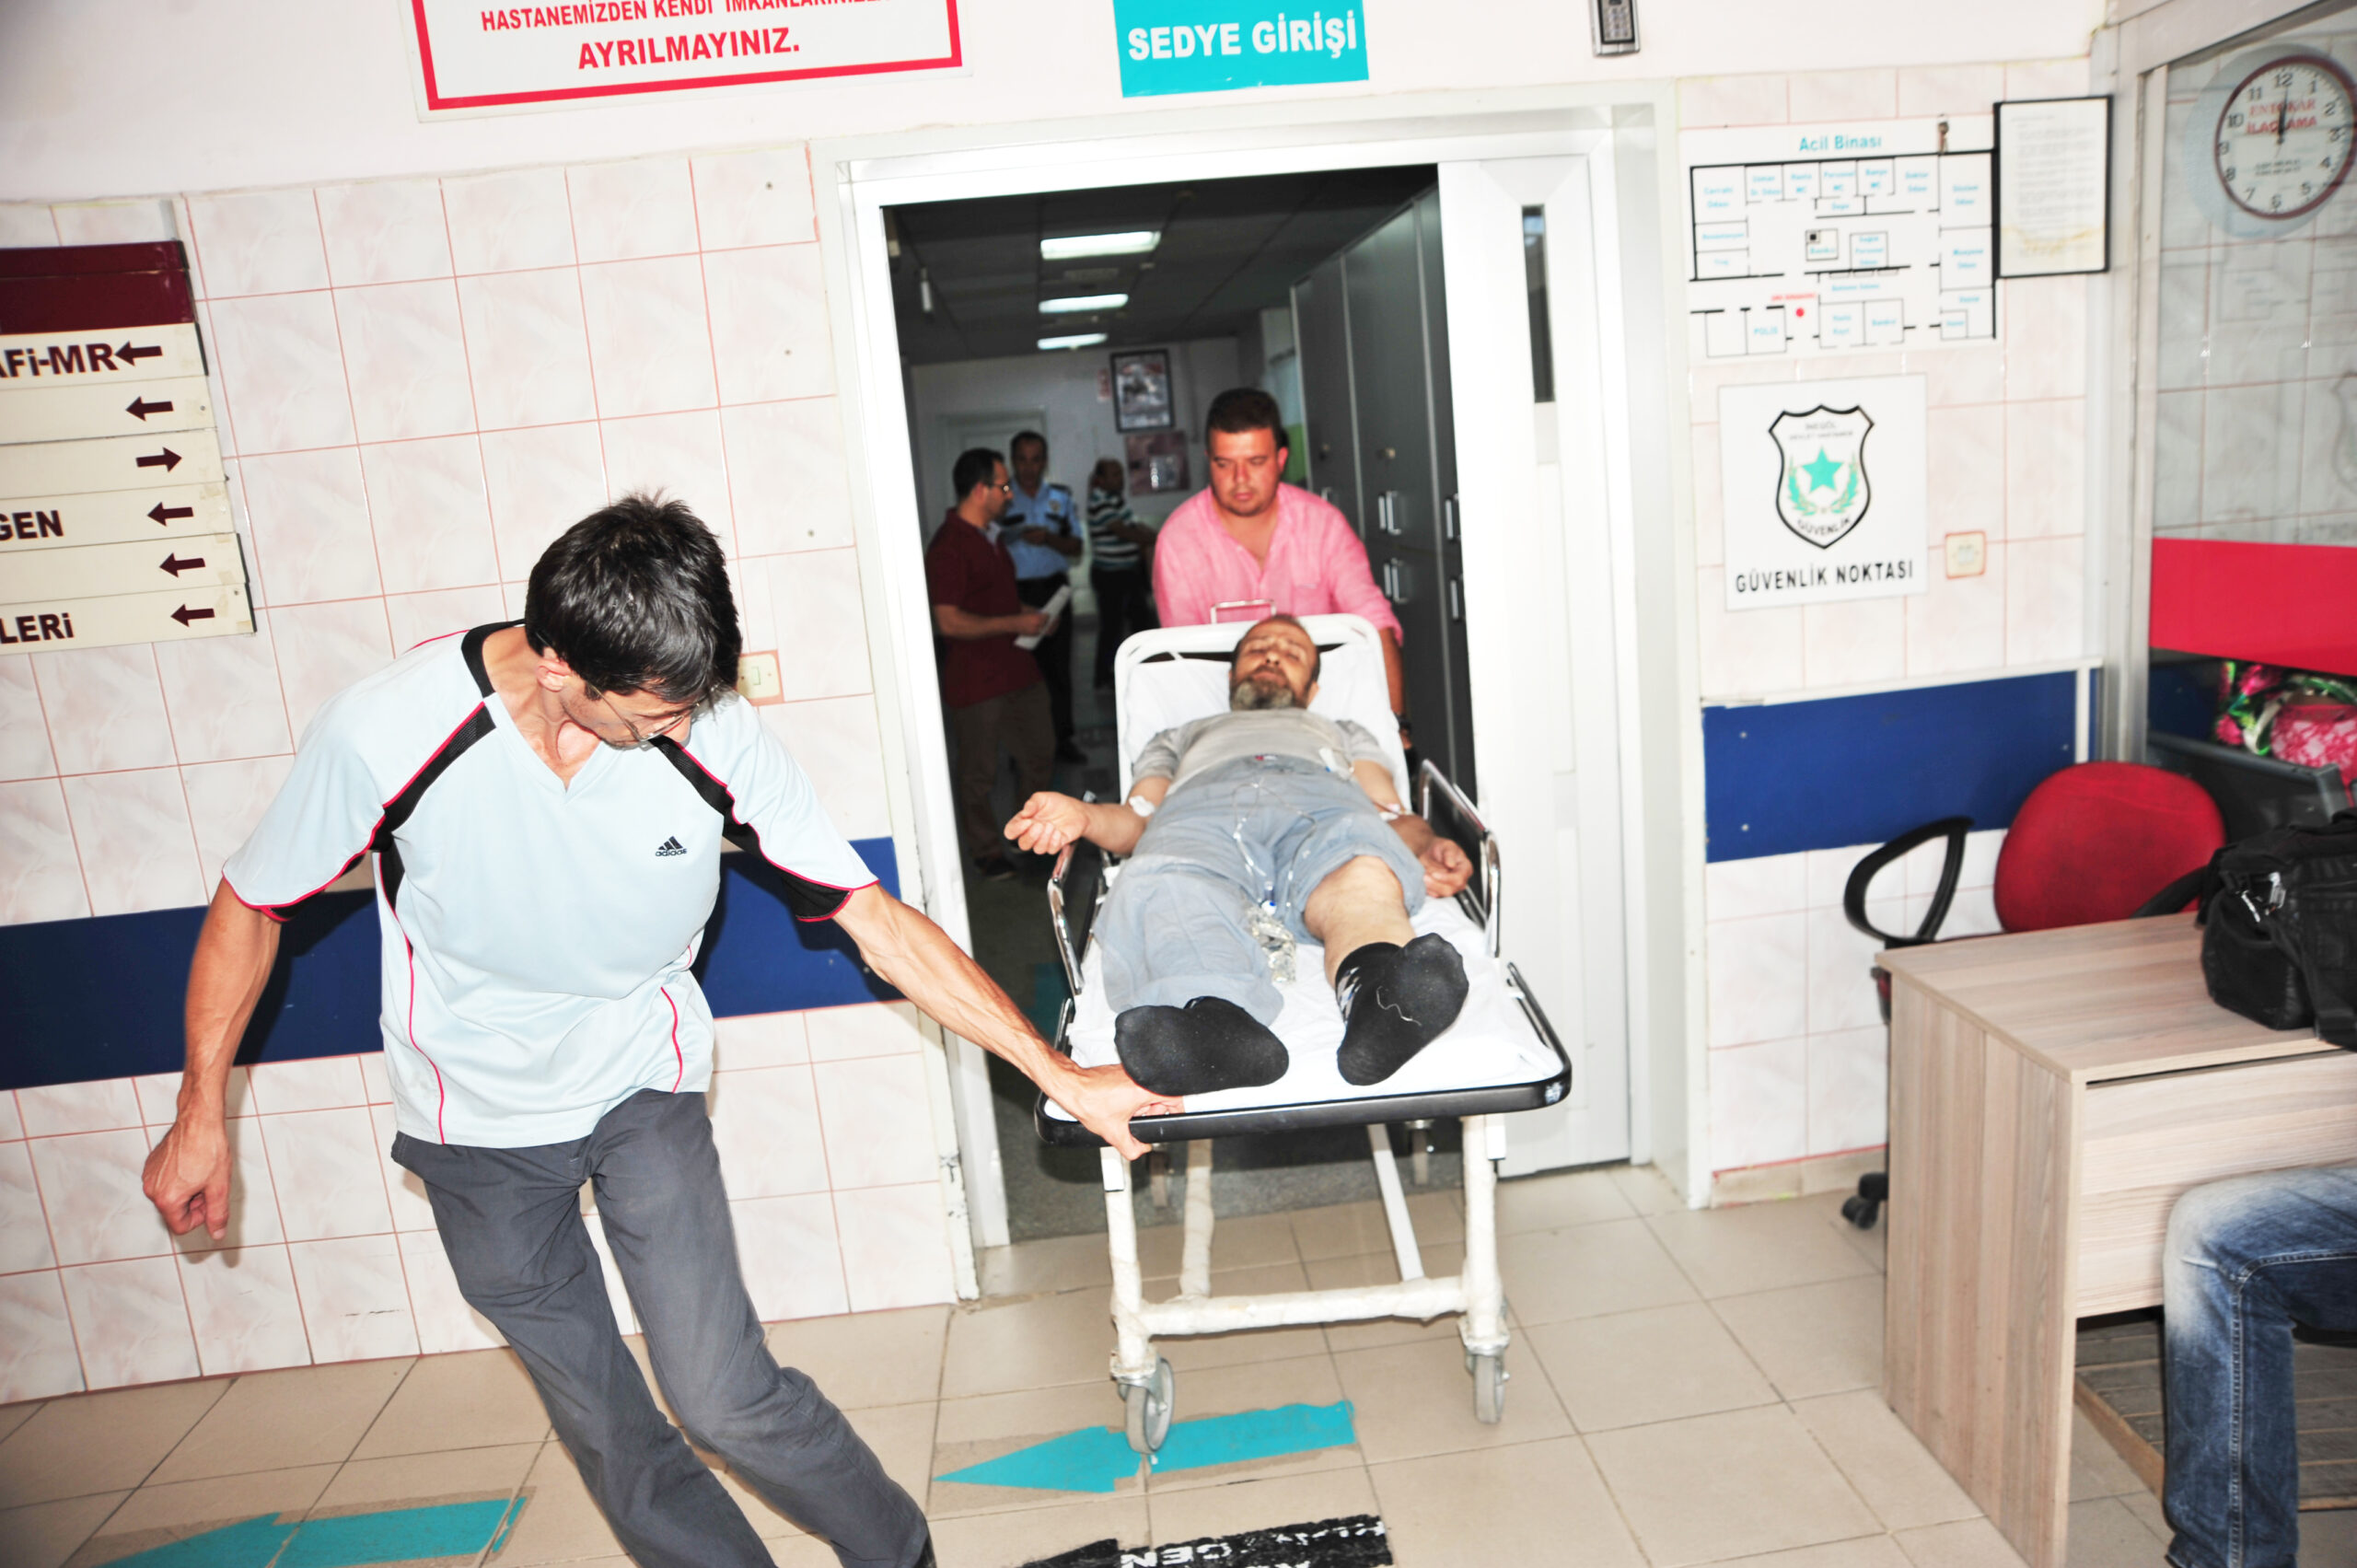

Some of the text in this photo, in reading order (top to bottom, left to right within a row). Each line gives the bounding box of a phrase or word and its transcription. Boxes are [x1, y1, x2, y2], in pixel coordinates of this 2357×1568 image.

[1128, 9, 1357, 61] SEDYE GİRİŞİ
[578, 27, 800, 70] AYRILMAYINIZ.
[2248, 87, 2262, 100] 11
[2275, 73, 2293, 88] 12
[2227, 113, 2244, 128] 10
[1799, 134, 1882, 152] Acil Binası
[0, 343, 120, 379] Fi-MR
[1736, 559, 1914, 593] GÜVENLİK NOKTASI
